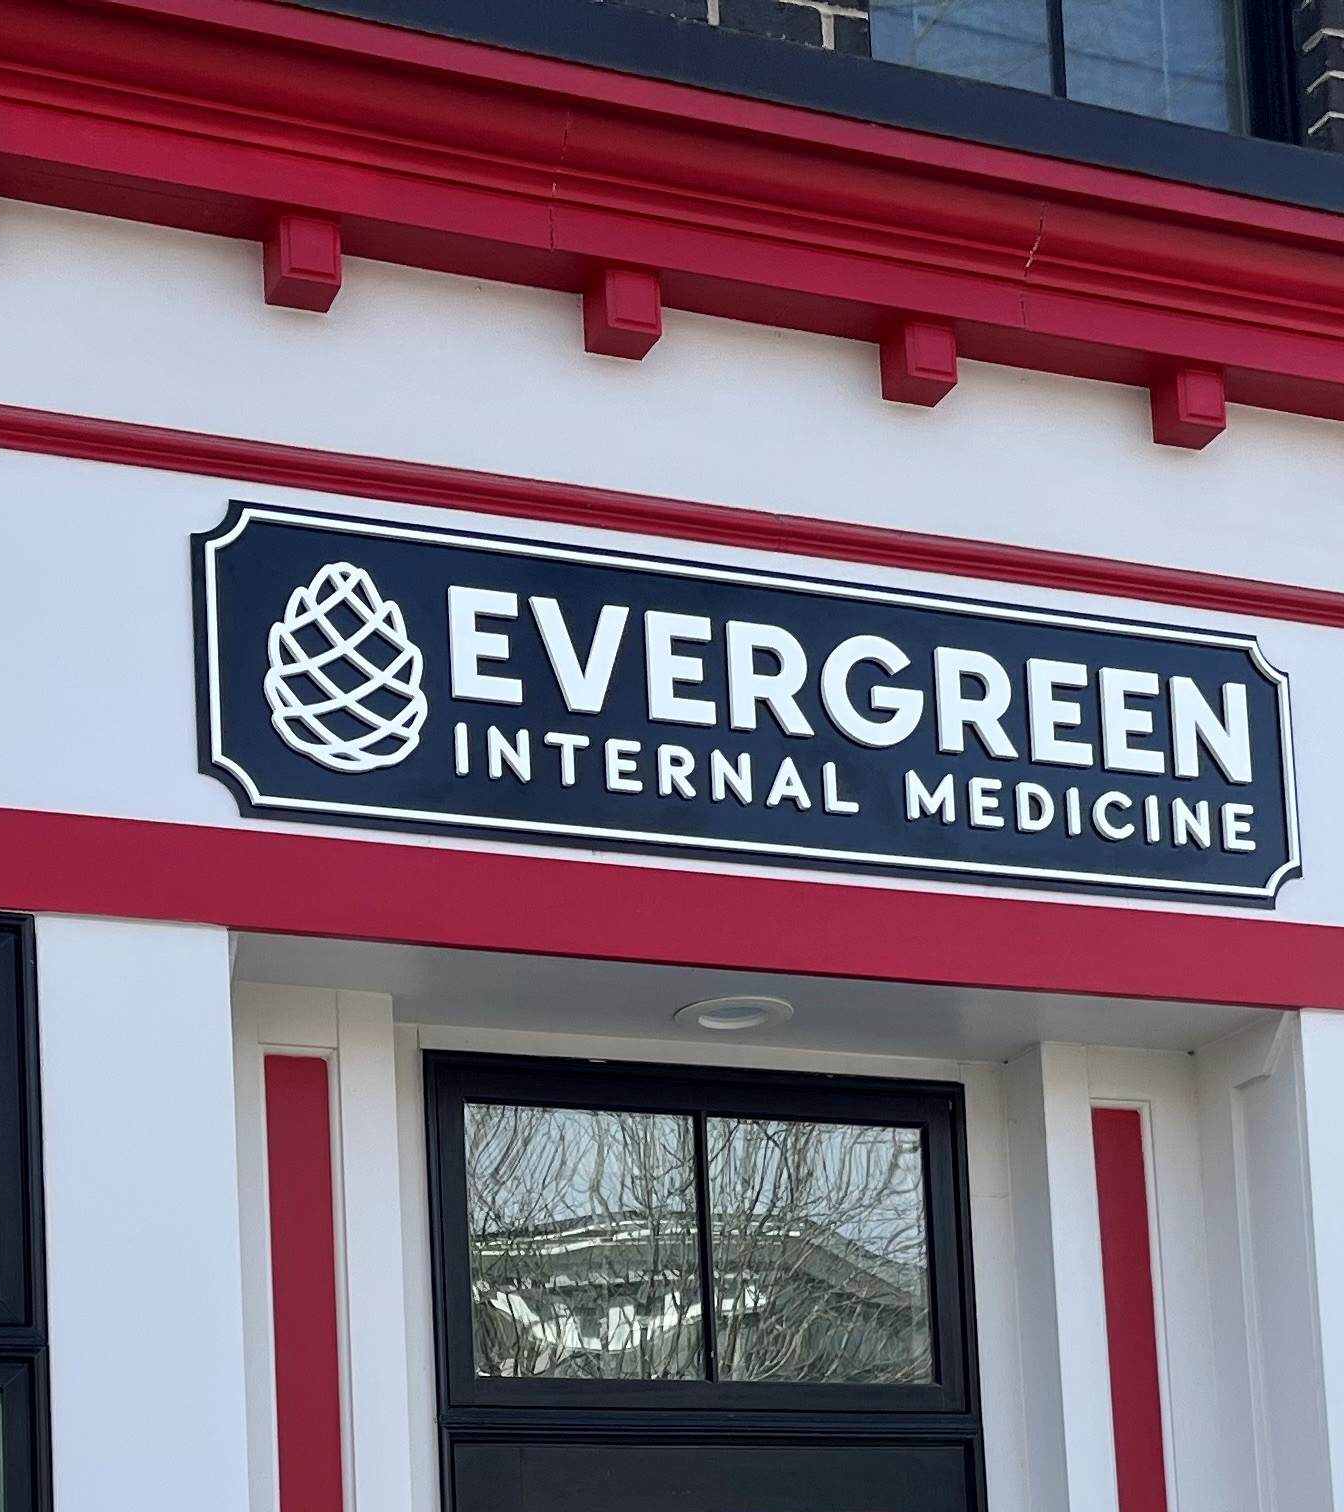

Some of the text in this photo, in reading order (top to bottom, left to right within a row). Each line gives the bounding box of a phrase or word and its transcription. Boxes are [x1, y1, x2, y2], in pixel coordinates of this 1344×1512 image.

[447, 584, 1253, 785] EVERGREEN
[453, 721, 1256, 852] INTERNAL MEDICINE
